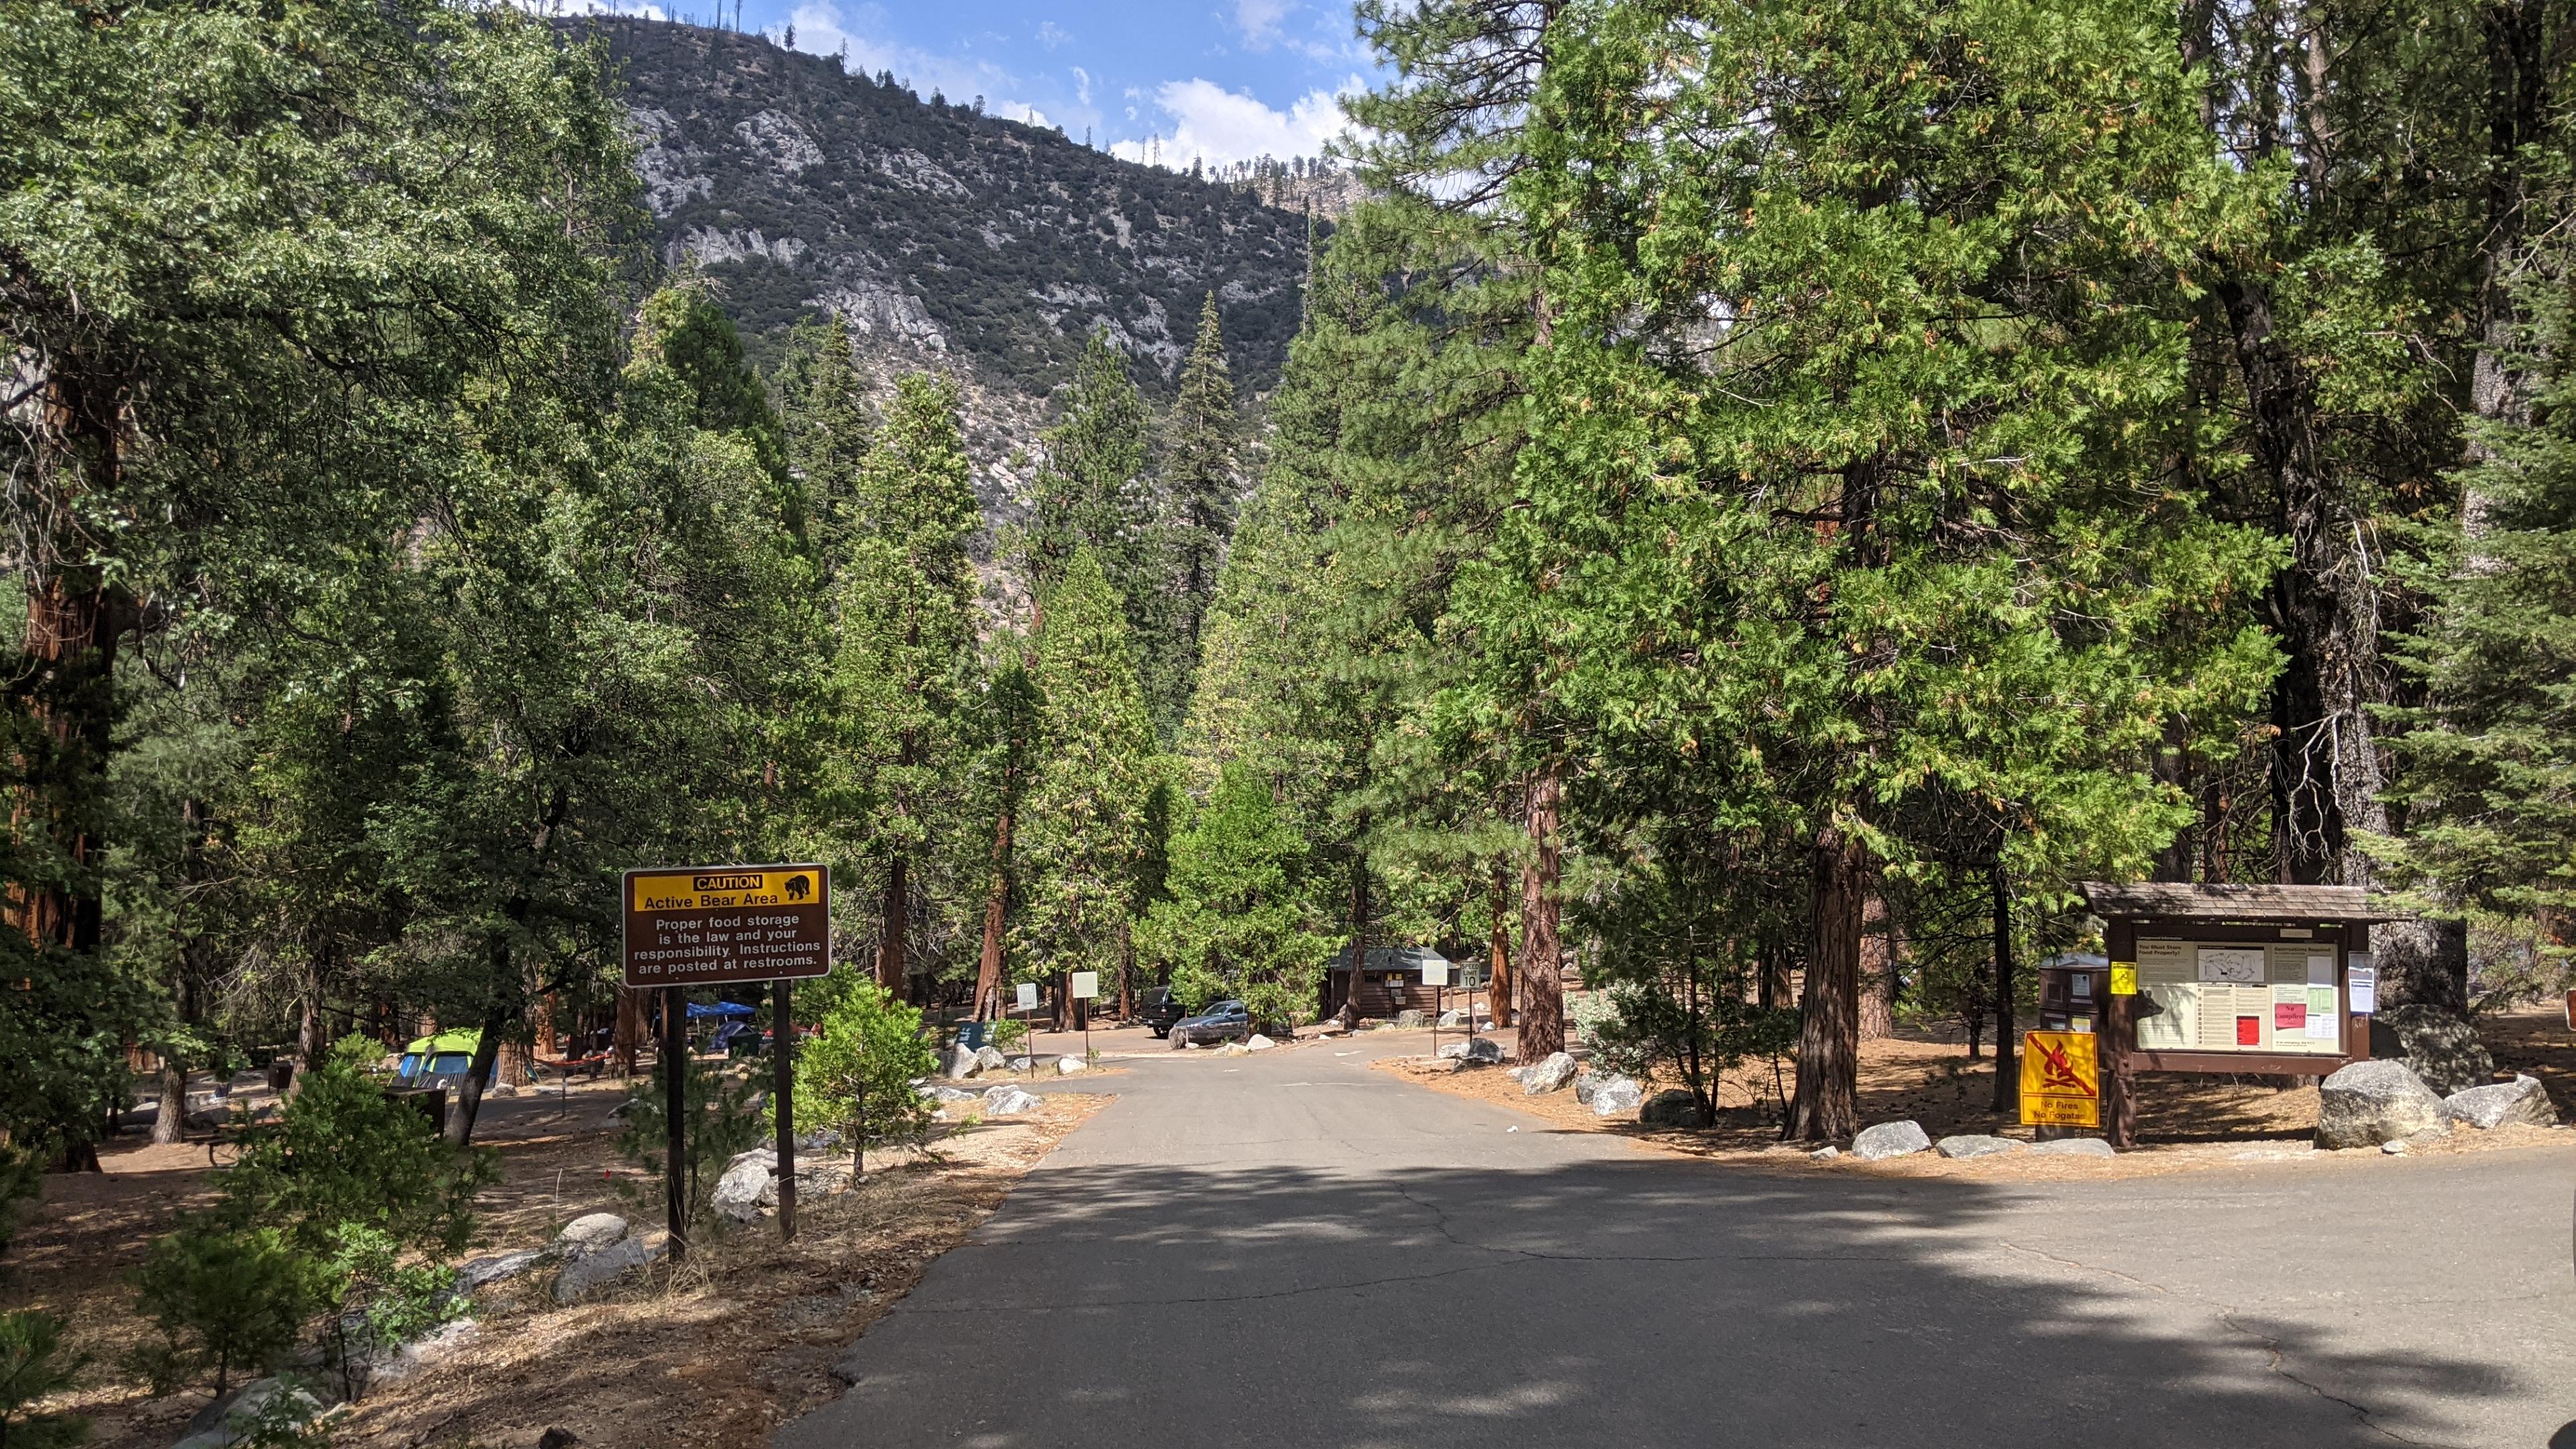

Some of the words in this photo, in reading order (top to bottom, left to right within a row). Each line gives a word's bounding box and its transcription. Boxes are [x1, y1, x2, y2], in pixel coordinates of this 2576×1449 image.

[696, 876, 760, 890] CAUTION
[644, 896, 693, 909] Active
[700, 895, 736, 906] Bear
[743, 893, 778, 905] Area
[656, 919, 702, 931] Proper
[708, 916, 741, 928] food
[747, 915, 800, 926] storage
[659, 934, 671, 945] is
[678, 932, 700, 943] the
[706, 931, 729, 942] law
[735, 929, 761, 941] and
[767, 929, 797, 941] your
[740, 941, 820, 955] Instructions
[639, 964, 661, 974] are
[667, 959, 717, 975] posted
[723, 959, 737, 970] at
[743, 956, 817, 968] restrooms.
[1465, 977, 1475, 986] 10
[2056, 1102, 2078, 1110] Fires
[2049, 1111, 2086, 1120] Fogatas
